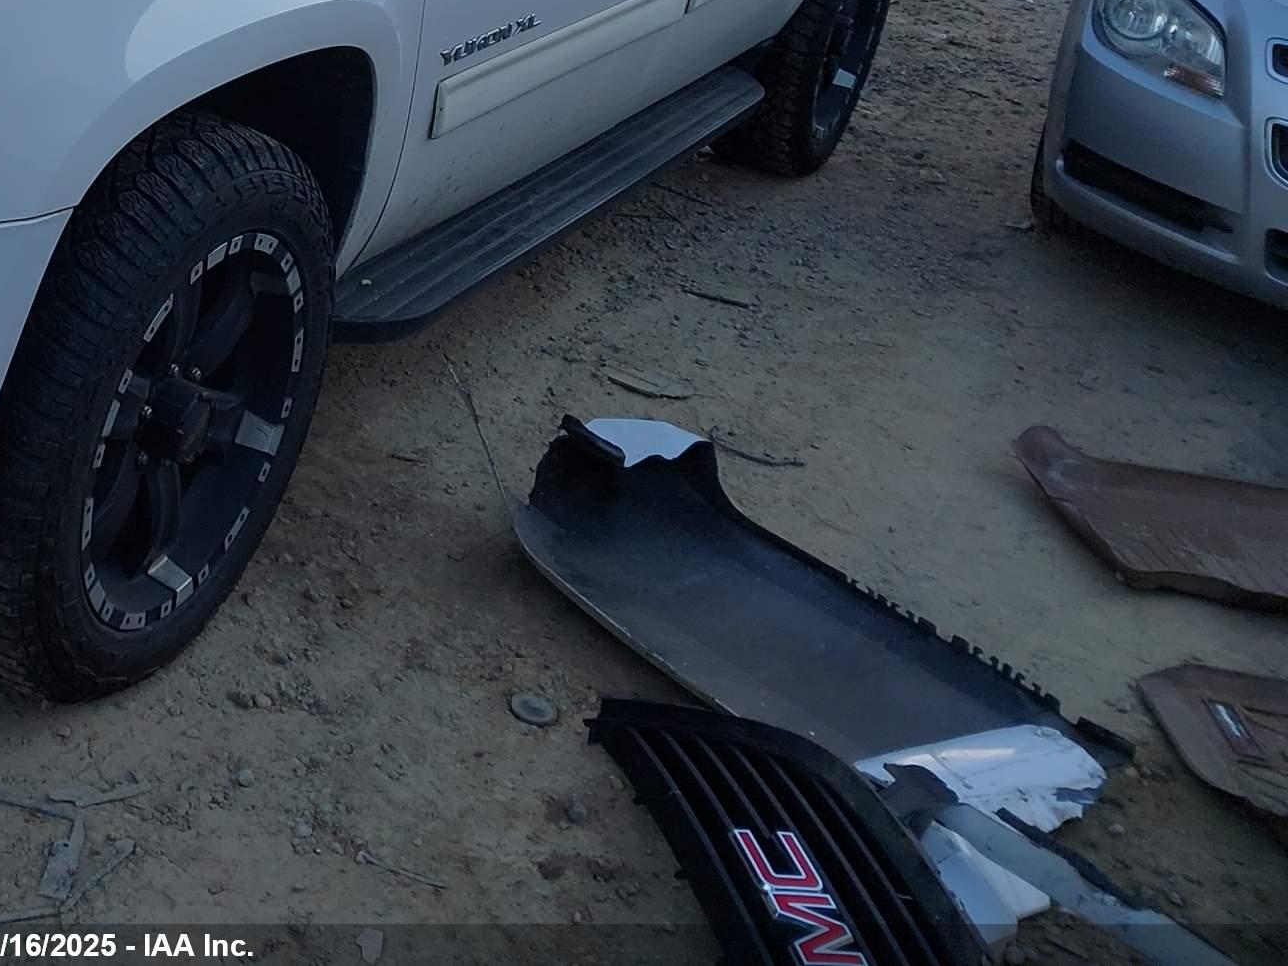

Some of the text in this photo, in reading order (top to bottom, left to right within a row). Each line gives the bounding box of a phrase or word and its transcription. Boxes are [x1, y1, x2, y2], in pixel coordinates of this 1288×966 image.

[440, 12, 543, 66] YUKON XL
[732, 828, 870, 966] MC
